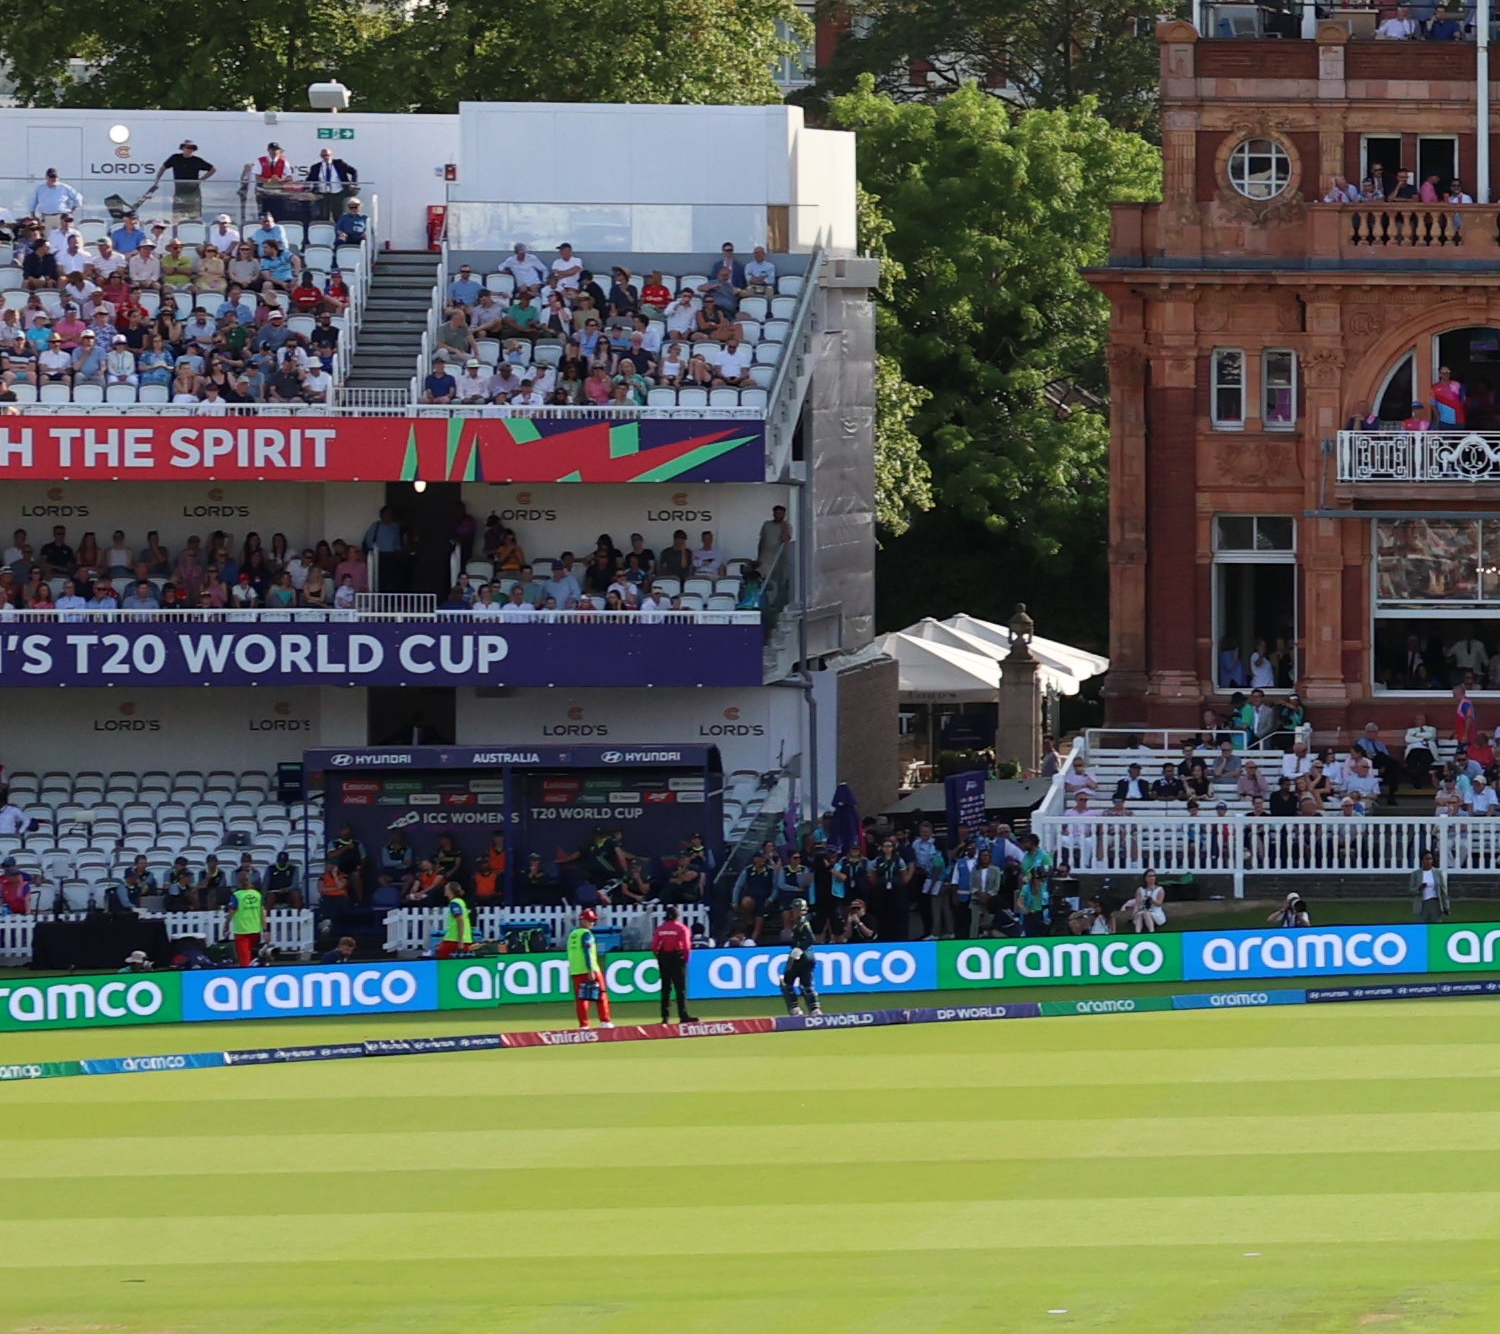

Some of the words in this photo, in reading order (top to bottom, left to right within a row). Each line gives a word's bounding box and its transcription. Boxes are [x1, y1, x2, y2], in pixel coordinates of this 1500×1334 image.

[91, 163, 155, 174] LORD'S
[0, 428, 32, 467] H
[51, 428, 155, 468] THE
[170, 428, 336, 468] SPIRIT
[22, 505, 90, 517] LORD'S
[183, 505, 250, 517] LORD'S
[647, 510, 712, 522] LORD'S
[0, 635, 53, 674] 'S
[67, 635, 166, 674] T20
[178, 634, 384, 674] WORLD
[400, 634, 508, 674] CUP
[94, 719, 161, 731] LORD'S
[543, 724, 608, 736] LORD'S
[699, 724, 764, 736] LORD'S
[355, 755, 411, 765] HYUNDAI
[472, 753, 540, 763] AUSTRALIA
[625, 751, 681, 761] HYUNDAI
[423, 812, 448, 824] ICC
[531, 807, 556, 819] T20
[558, 807, 612, 819] WORLD
[615, 807, 643, 819] CUP
[1202, 930, 1407, 972] aramco
[956, 940, 1164, 980] aramco
[203, 969, 416, 1012] aramco
[1210, 992, 1268, 1006] aramco
[1076, 999, 1135, 1013] aramco
[936, 1009, 956, 1020] DP
[957, 1006, 1007, 1019] WORLD
[805, 1016, 824, 1028] DP
[825, 1013, 874, 1026] WORLD
[679, 1022, 736, 1037] Emirates
[543, 1031, 599, 1044] Emirates
[123, 1055, 186, 1070] aramco
